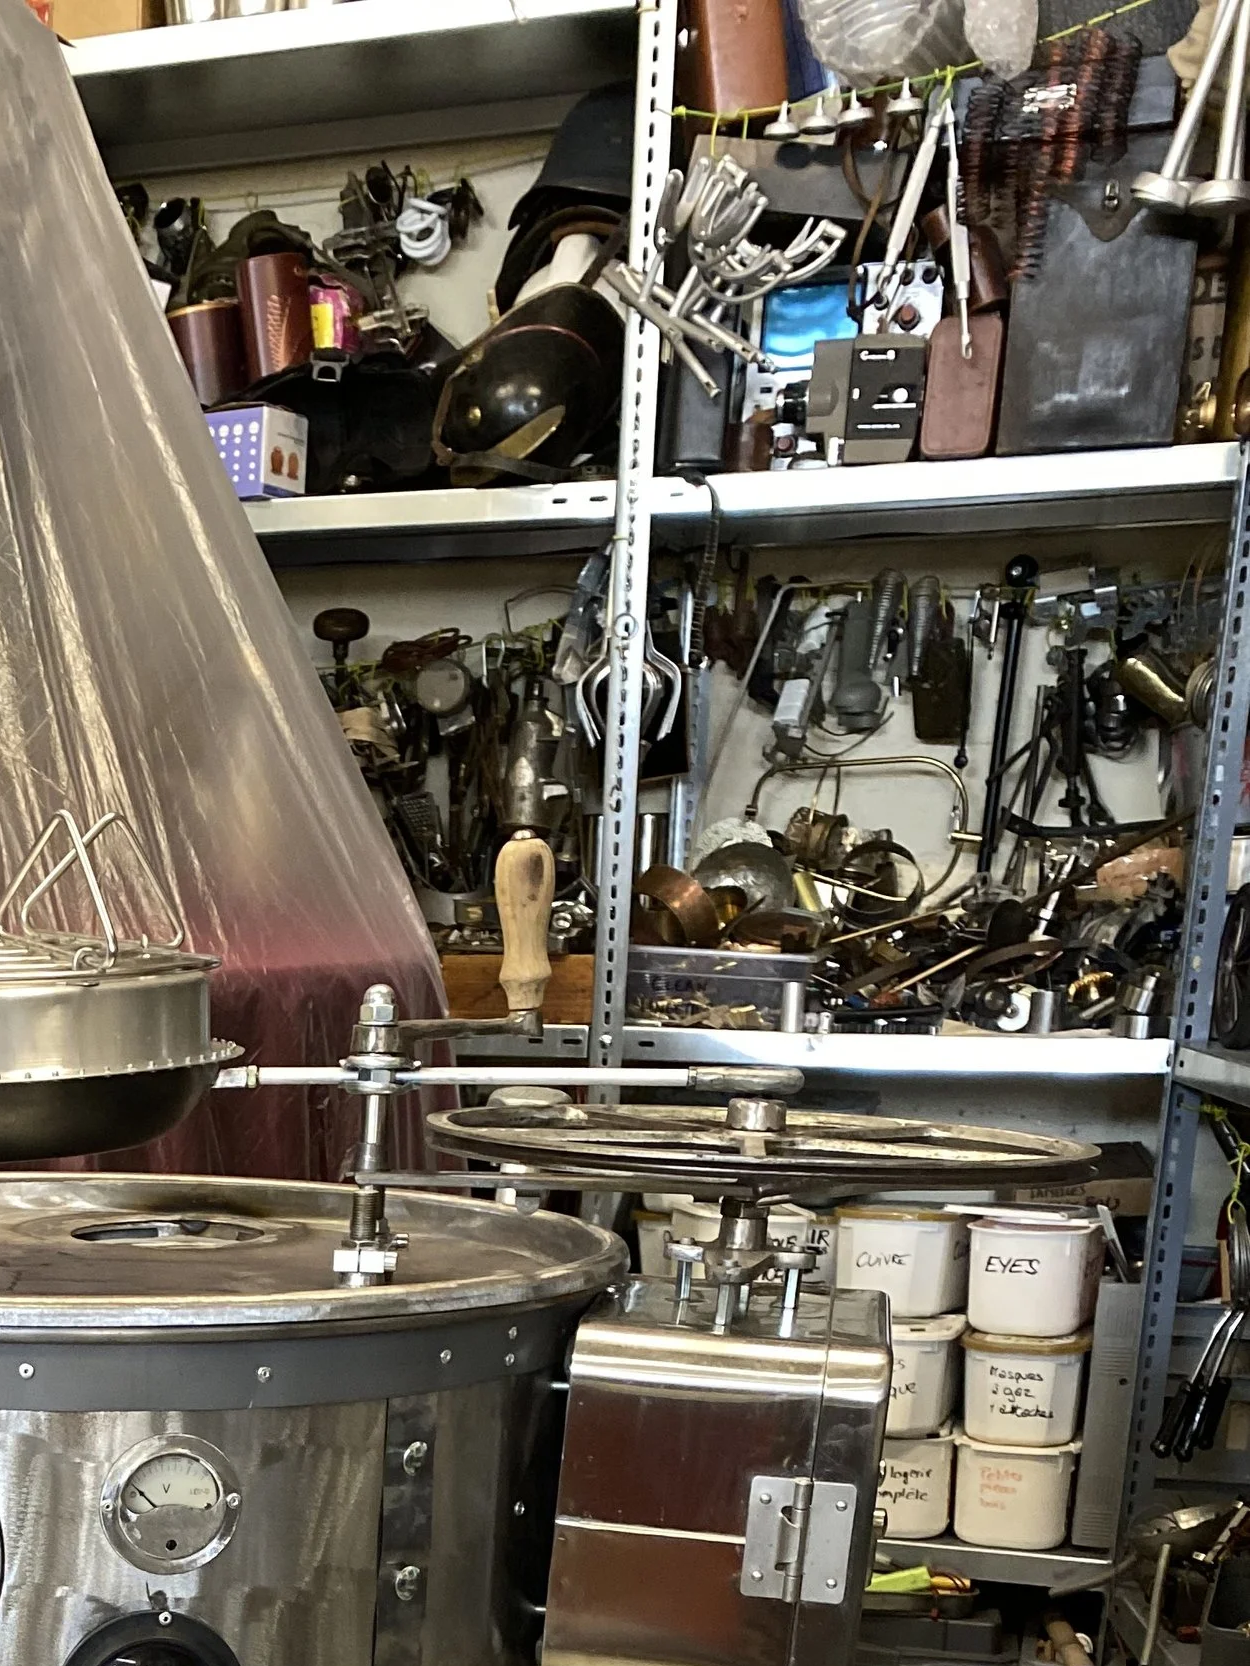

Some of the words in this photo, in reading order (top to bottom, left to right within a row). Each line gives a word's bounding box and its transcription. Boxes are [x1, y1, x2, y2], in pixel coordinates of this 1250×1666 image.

[856, 1251, 912, 1268] CUIVRE
[985, 1255, 1041, 1276] EYES
[989, 1365, 1044, 1384] Masques
[890, 1381, 917, 1400] que
[162, 1483, 171, 1494] V
[878, 1488, 928, 1504] mplète
